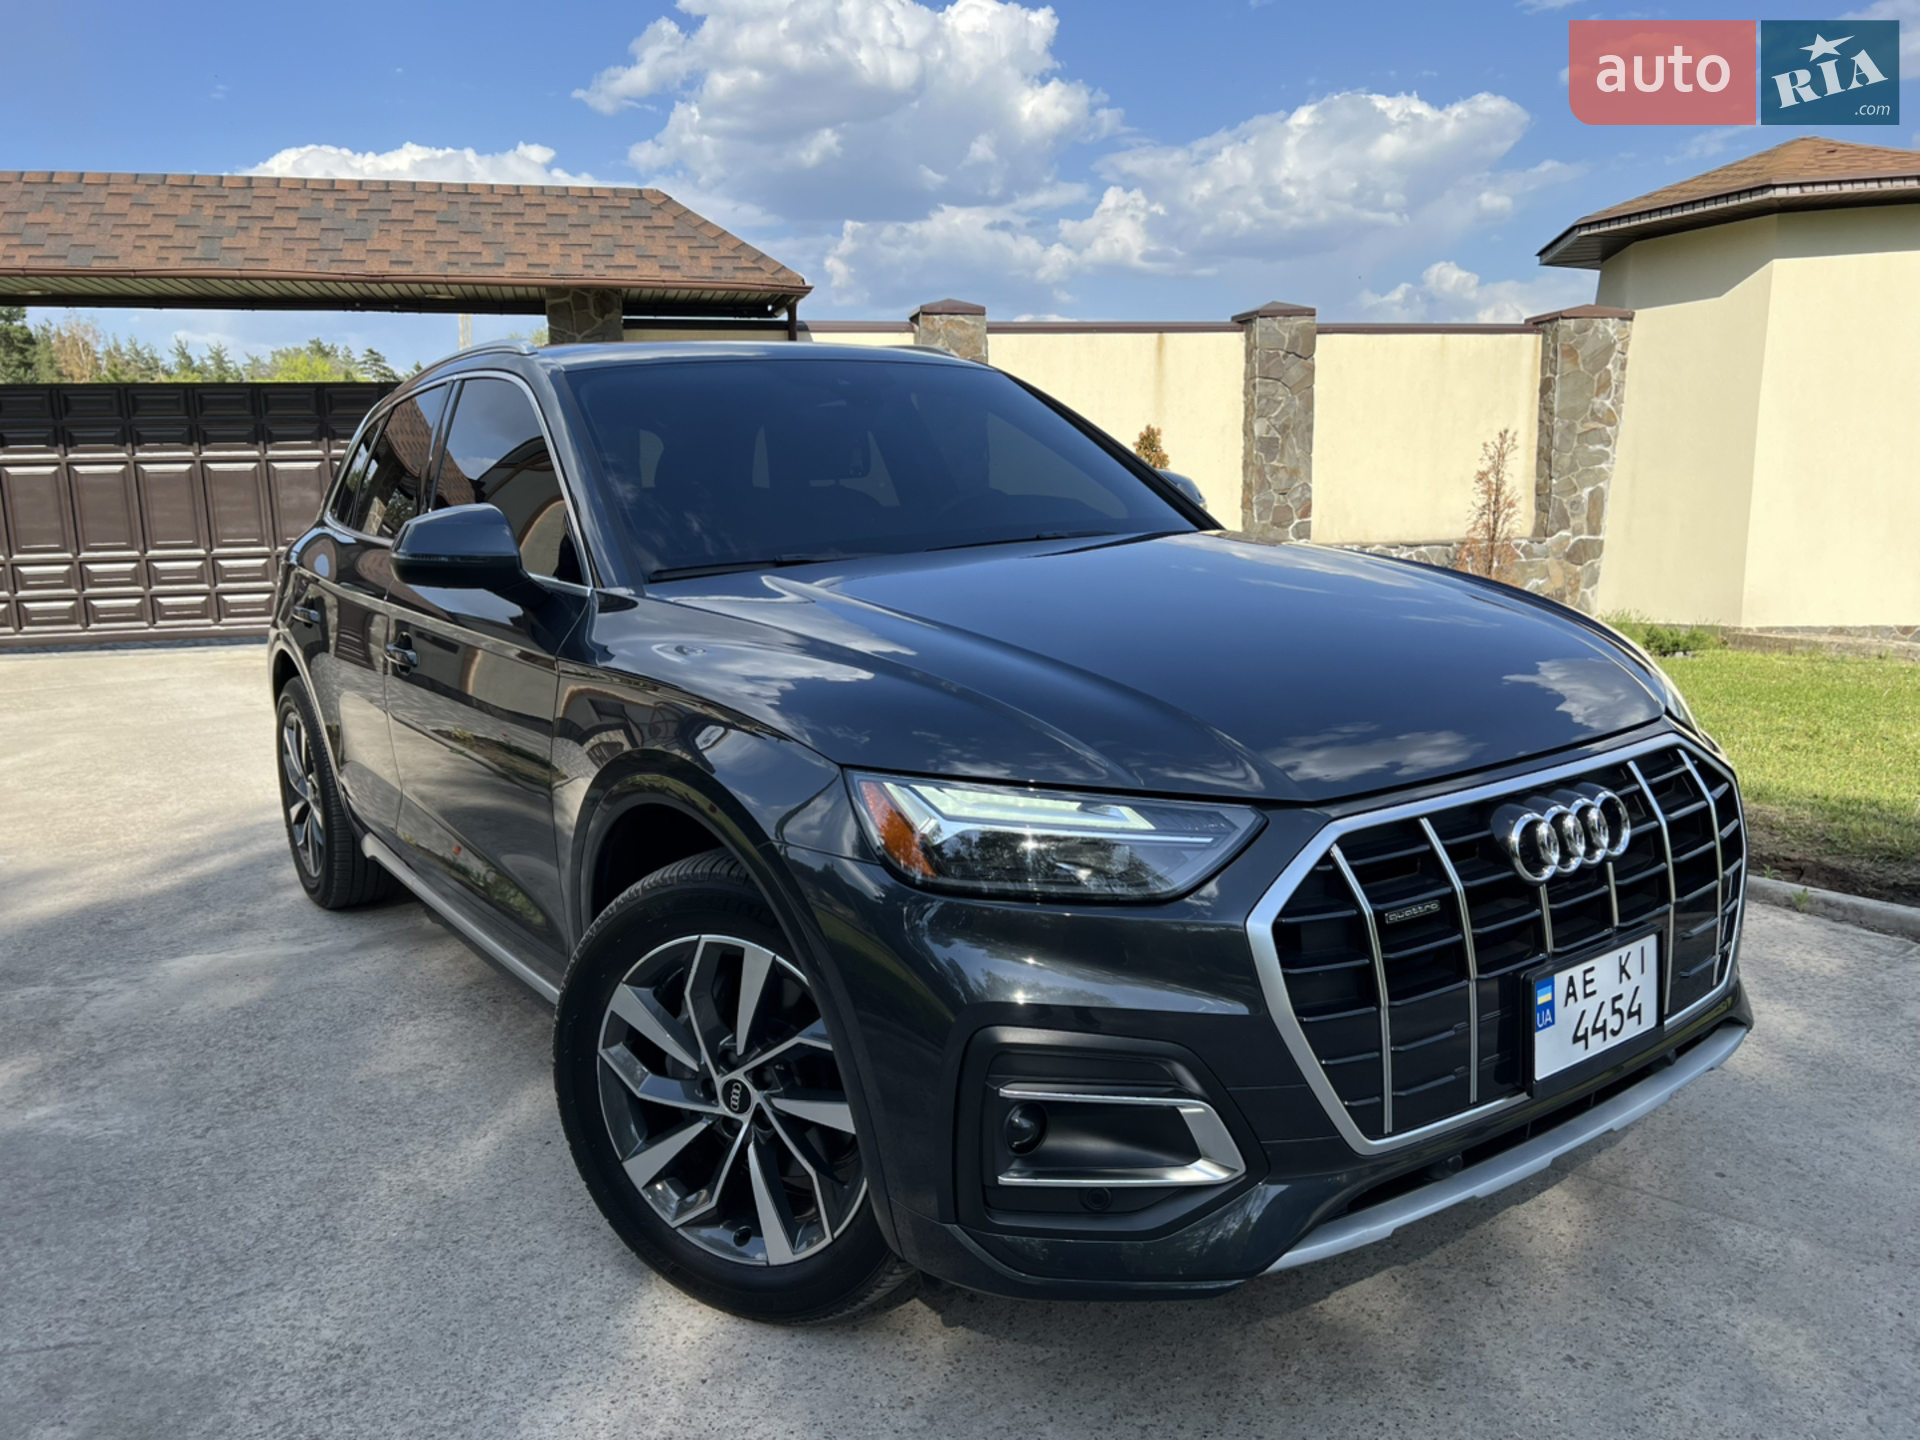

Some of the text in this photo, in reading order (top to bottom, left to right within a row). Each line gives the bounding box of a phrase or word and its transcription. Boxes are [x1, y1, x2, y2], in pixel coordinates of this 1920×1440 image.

[1388, 903, 1439, 921] quattro
[1564, 946, 1645, 1008] AE KI
[1536, 1008, 1553, 1027] UA
[1572, 985, 1642, 1051] 4454
